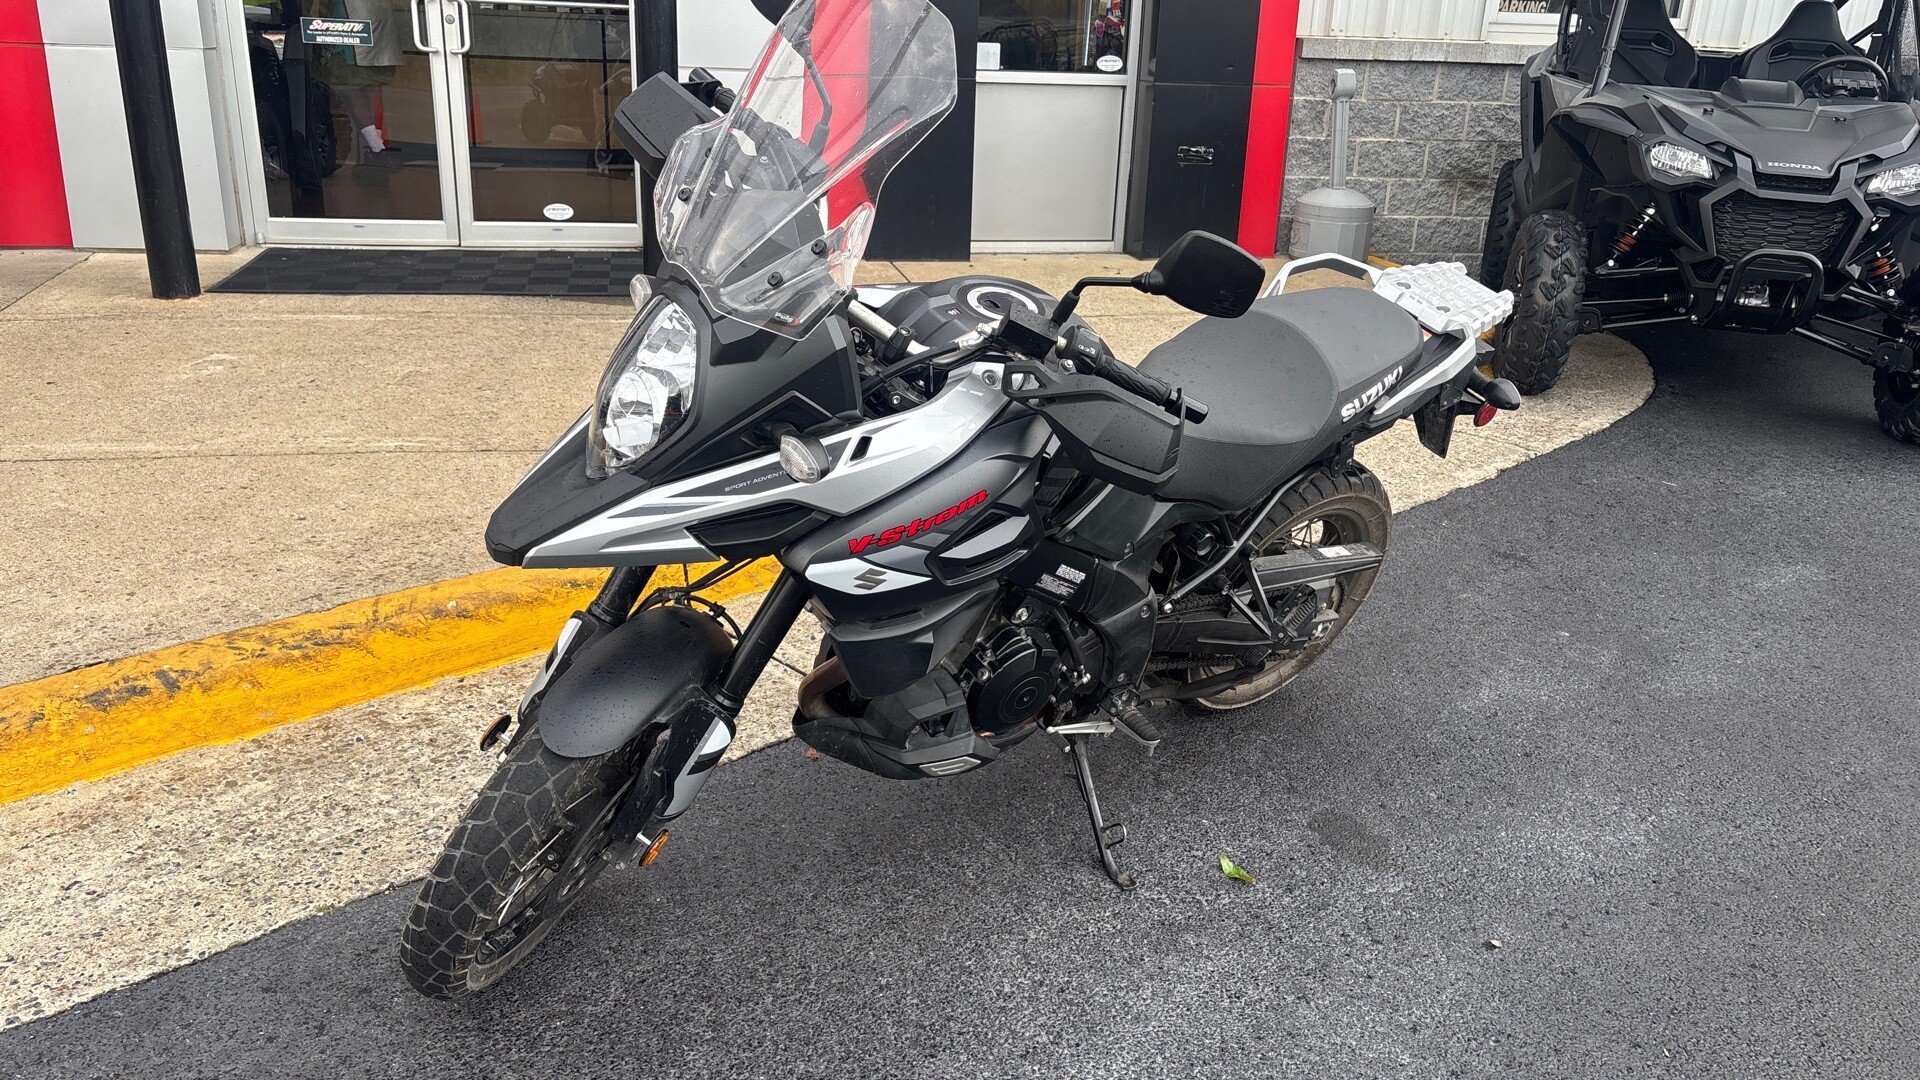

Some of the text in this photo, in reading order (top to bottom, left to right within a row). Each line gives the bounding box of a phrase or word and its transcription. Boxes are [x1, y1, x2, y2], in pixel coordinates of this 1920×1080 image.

[1767, 161, 1824, 171] HONDA
[1341, 365, 1403, 422] SUZUKI
[724, 480, 751, 492] SPORT
[848, 489, 989, 554] V-Strom
